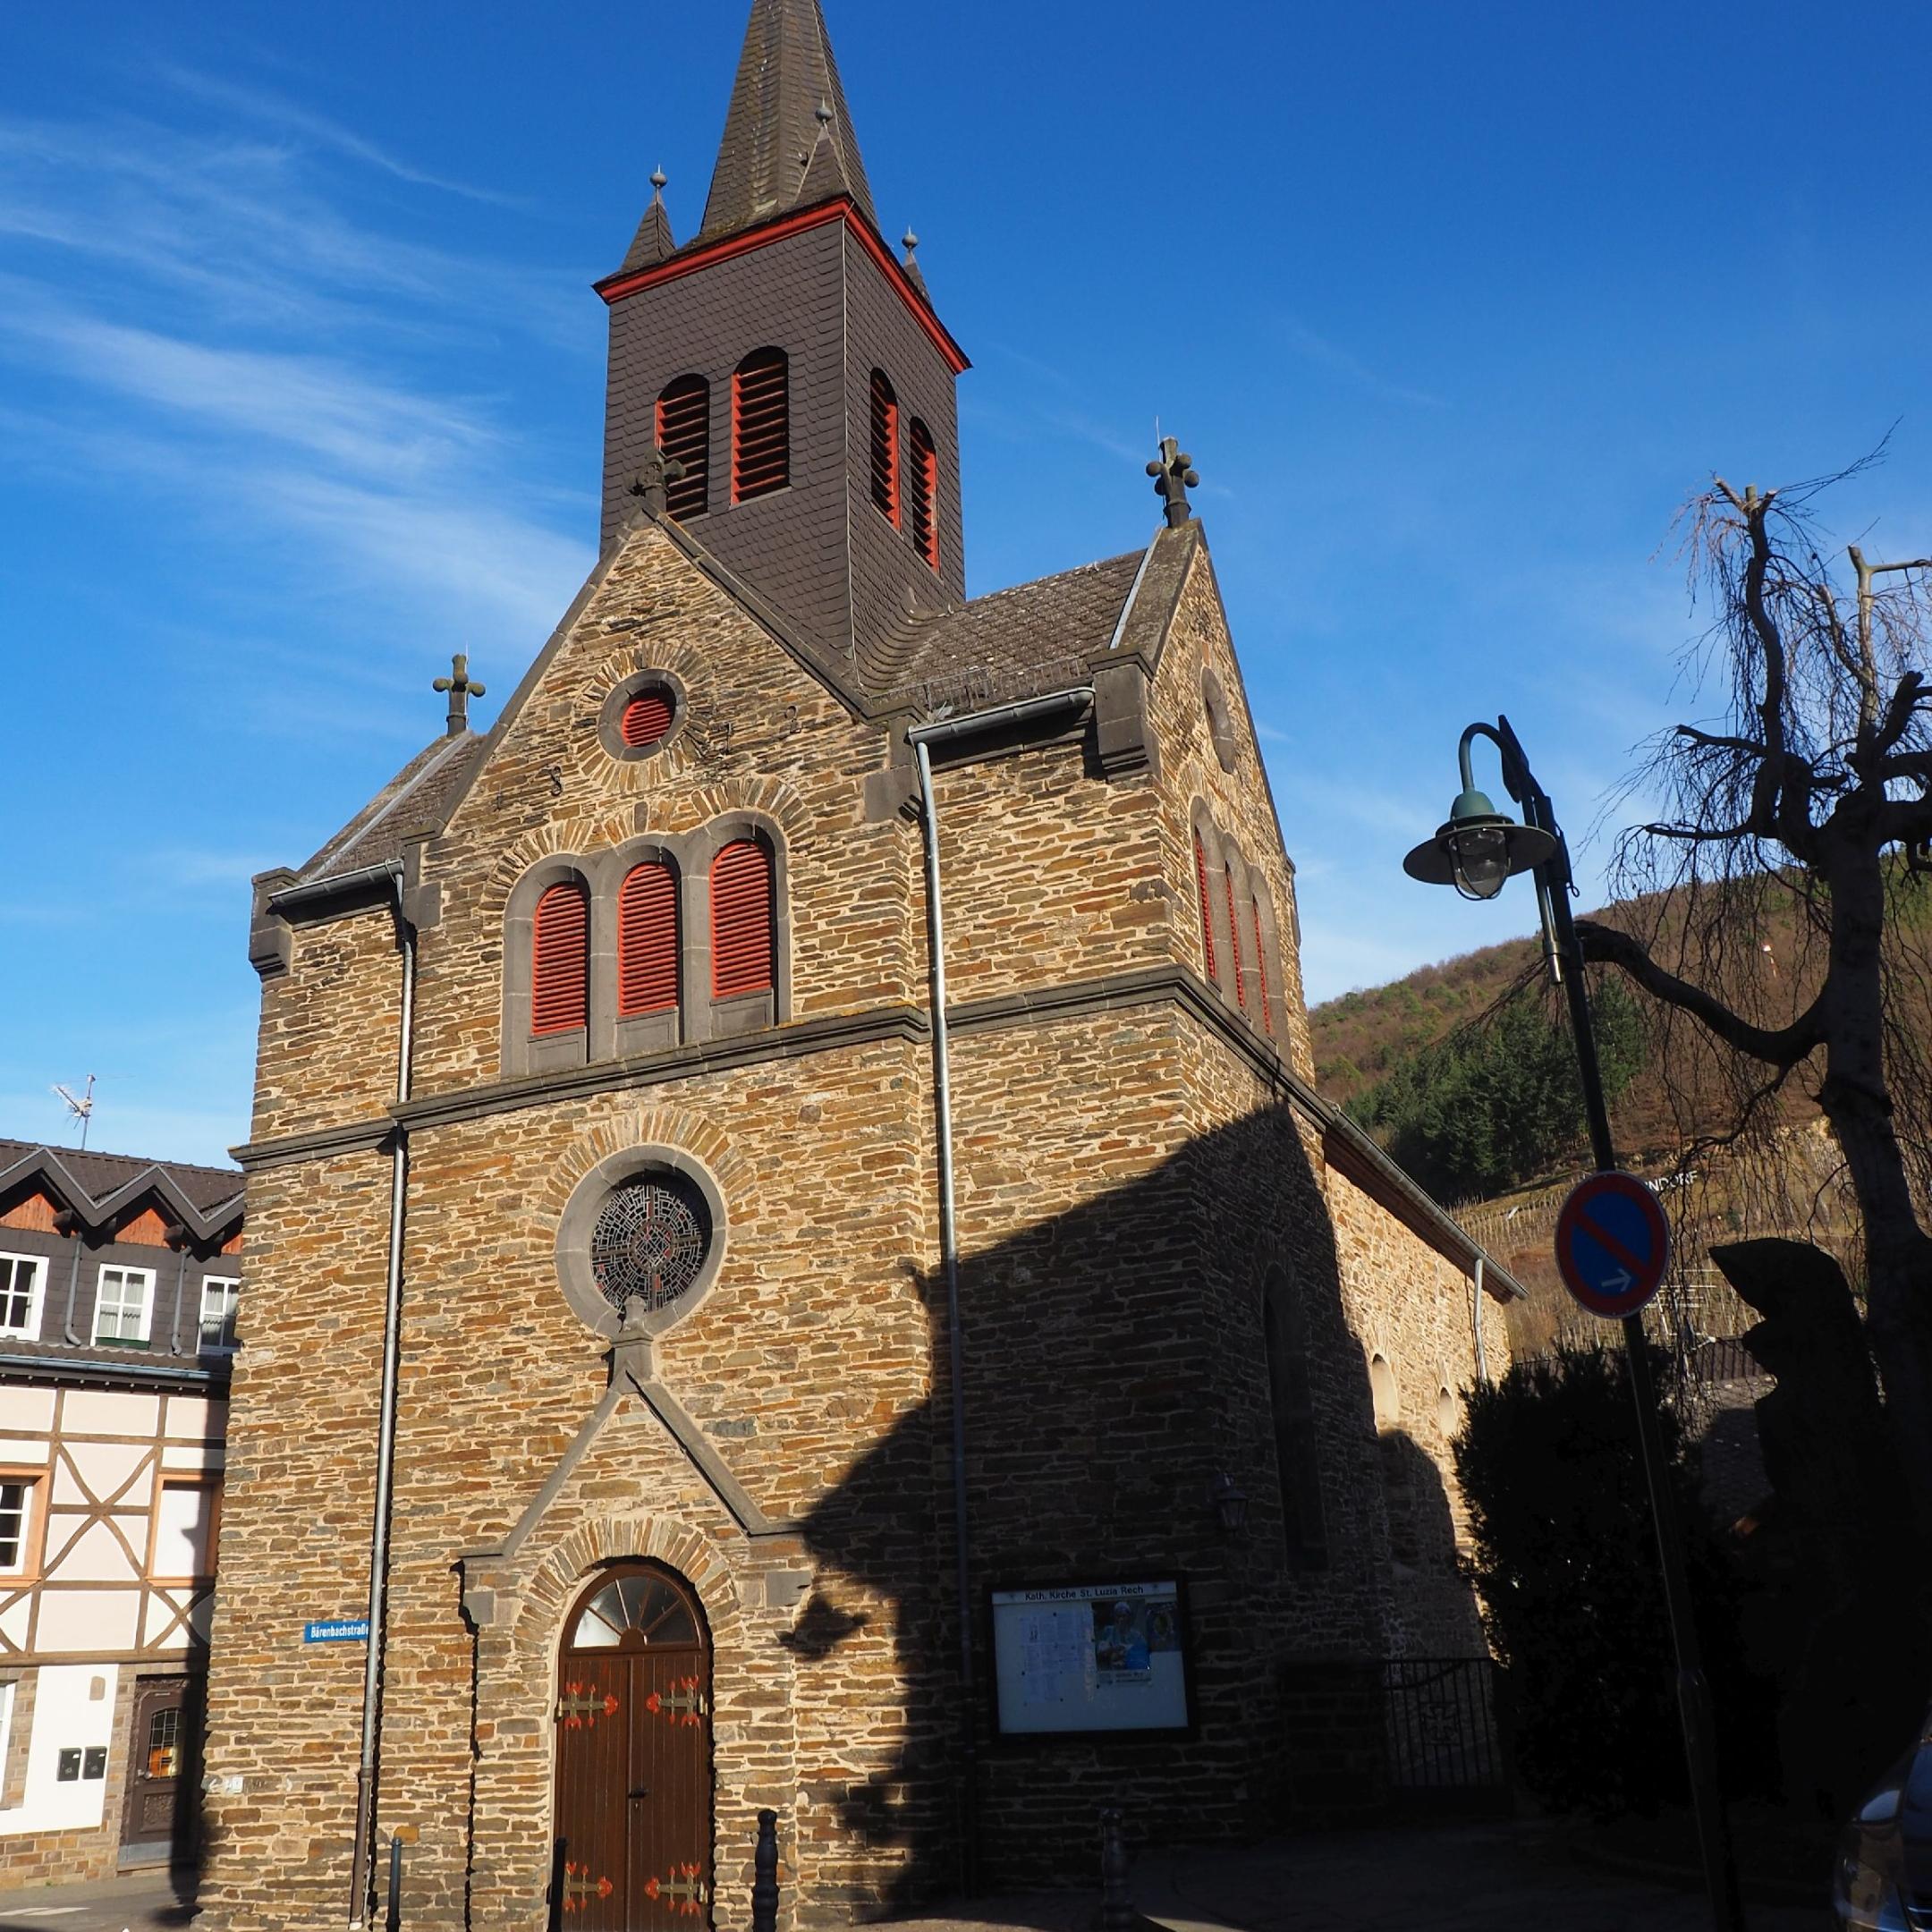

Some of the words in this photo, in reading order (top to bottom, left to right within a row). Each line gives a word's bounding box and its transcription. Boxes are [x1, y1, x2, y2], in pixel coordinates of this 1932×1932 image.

[1645, 1170, 1698, 1191] NDORF
[1025, 1592, 1046, 1601] Kath.
[1049, 1590, 1076, 1599] Kirche
[1080, 1589, 1092, 1597] St.
[1096, 1588, 1117, 1596] Luzia
[1121, 1585, 1143, 1594] Rech
